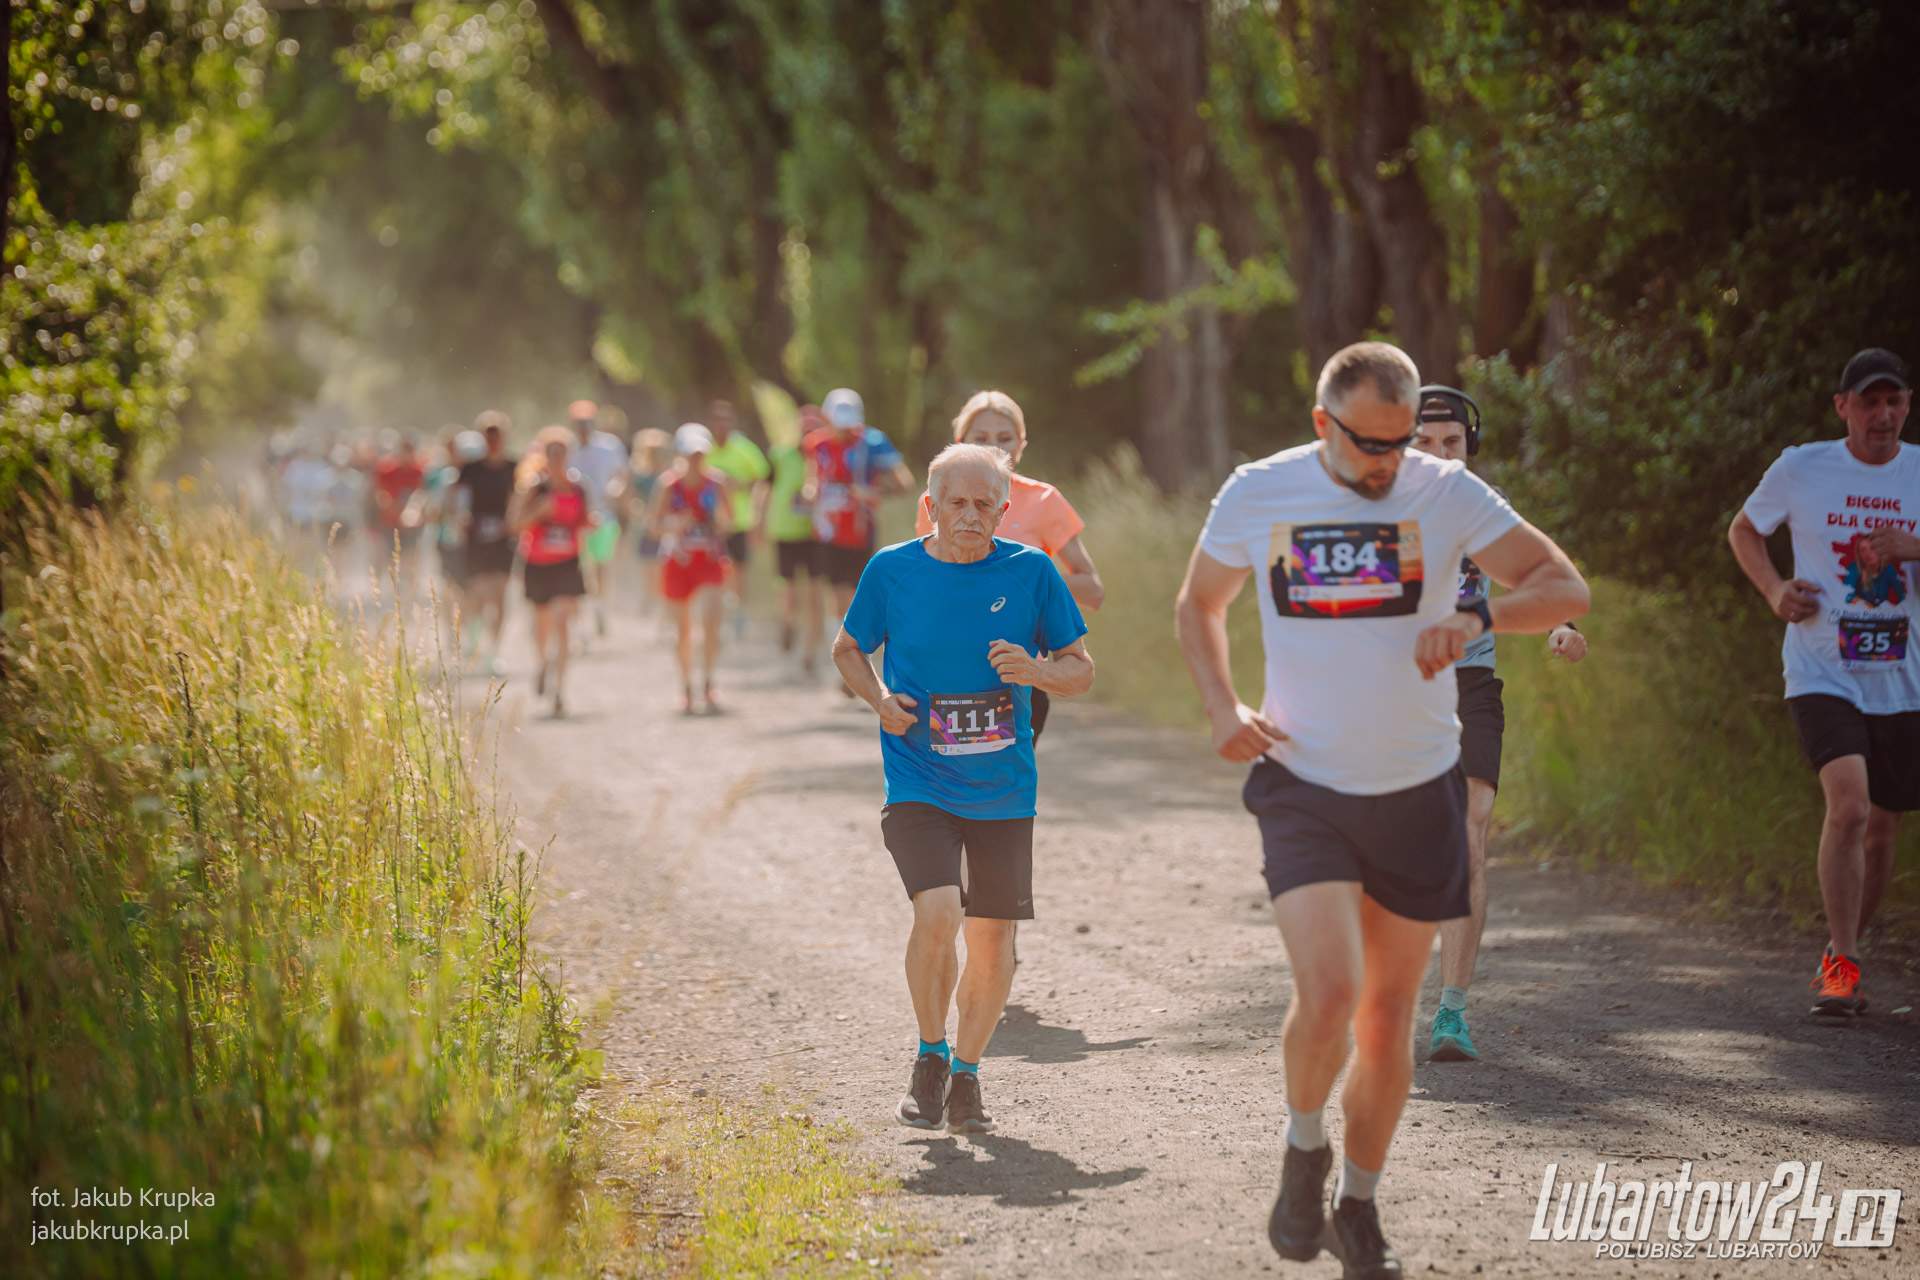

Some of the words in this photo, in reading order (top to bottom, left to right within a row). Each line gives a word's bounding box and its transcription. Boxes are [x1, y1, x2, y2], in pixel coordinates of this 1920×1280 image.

[1827, 512, 1858, 528] DLA
[1864, 516, 1917, 533] EDYTY
[1309, 541, 1380, 574] 184
[1858, 631, 1890, 653] 35
[947, 708, 999, 734] 111
